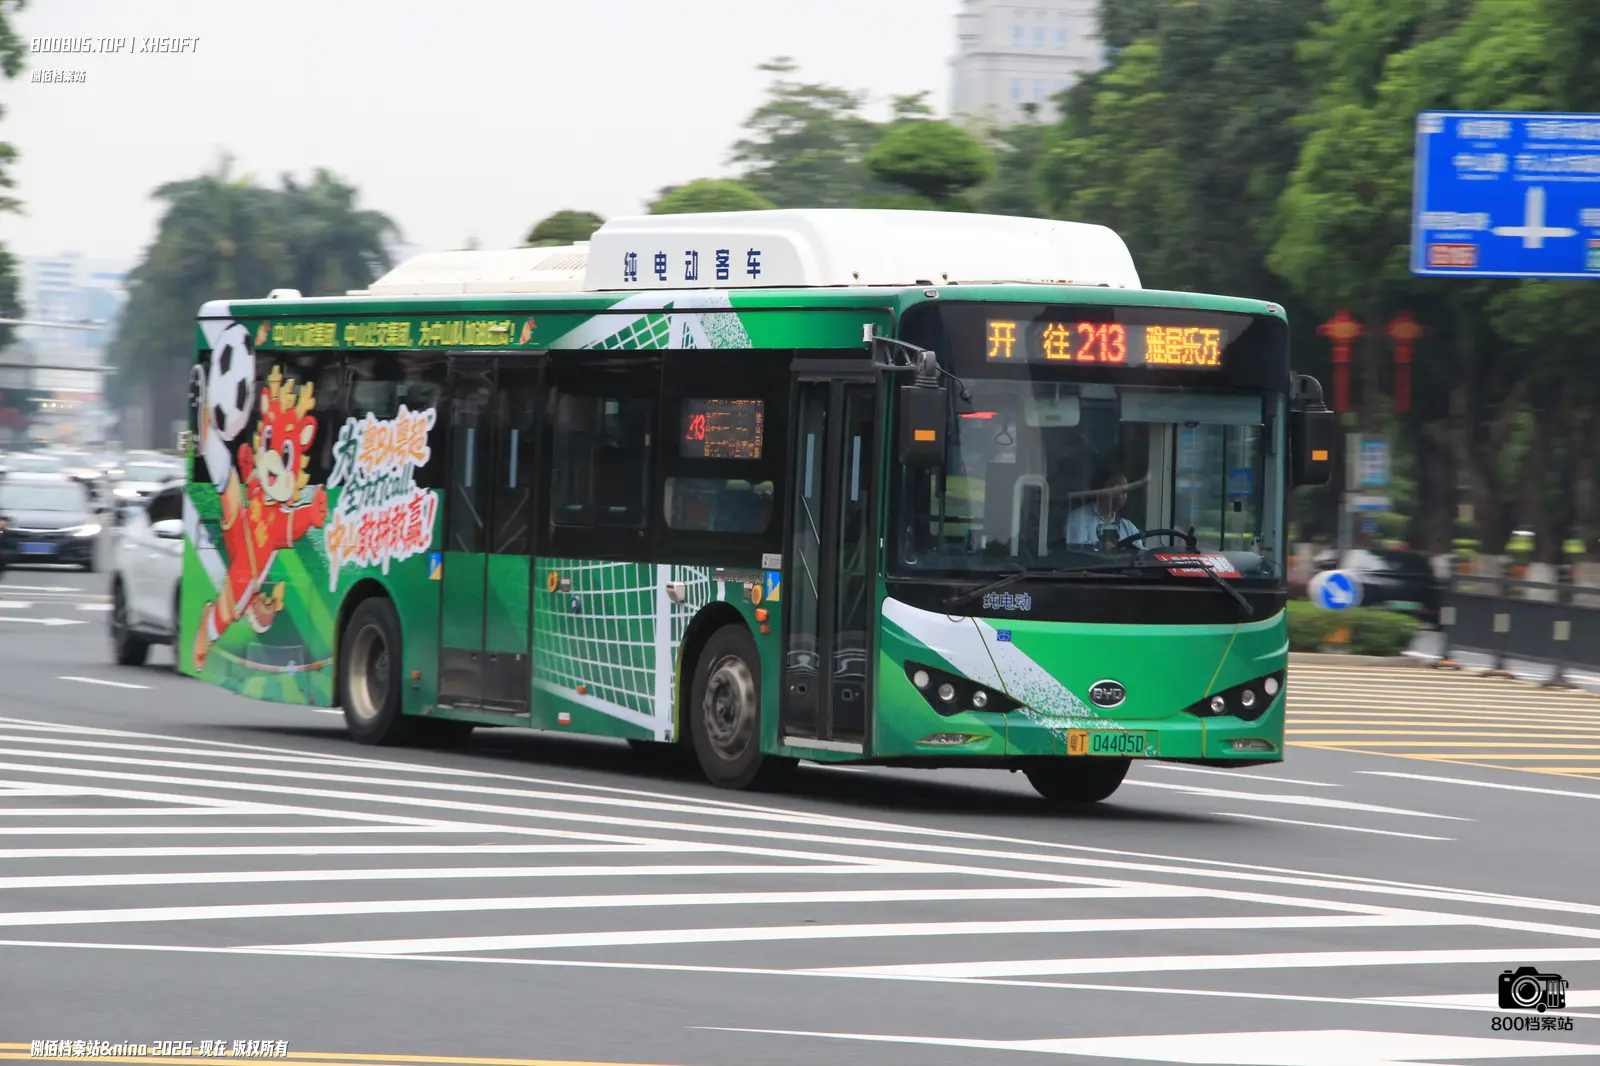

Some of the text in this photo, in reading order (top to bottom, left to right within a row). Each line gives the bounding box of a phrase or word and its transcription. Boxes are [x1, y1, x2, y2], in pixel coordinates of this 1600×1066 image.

[624, 248, 761, 282] 纯电动客车
[1074, 320, 1127, 363] 213
[982, 592, 1032, 611] 纯电动
[1093, 688, 1123, 701] BYD
